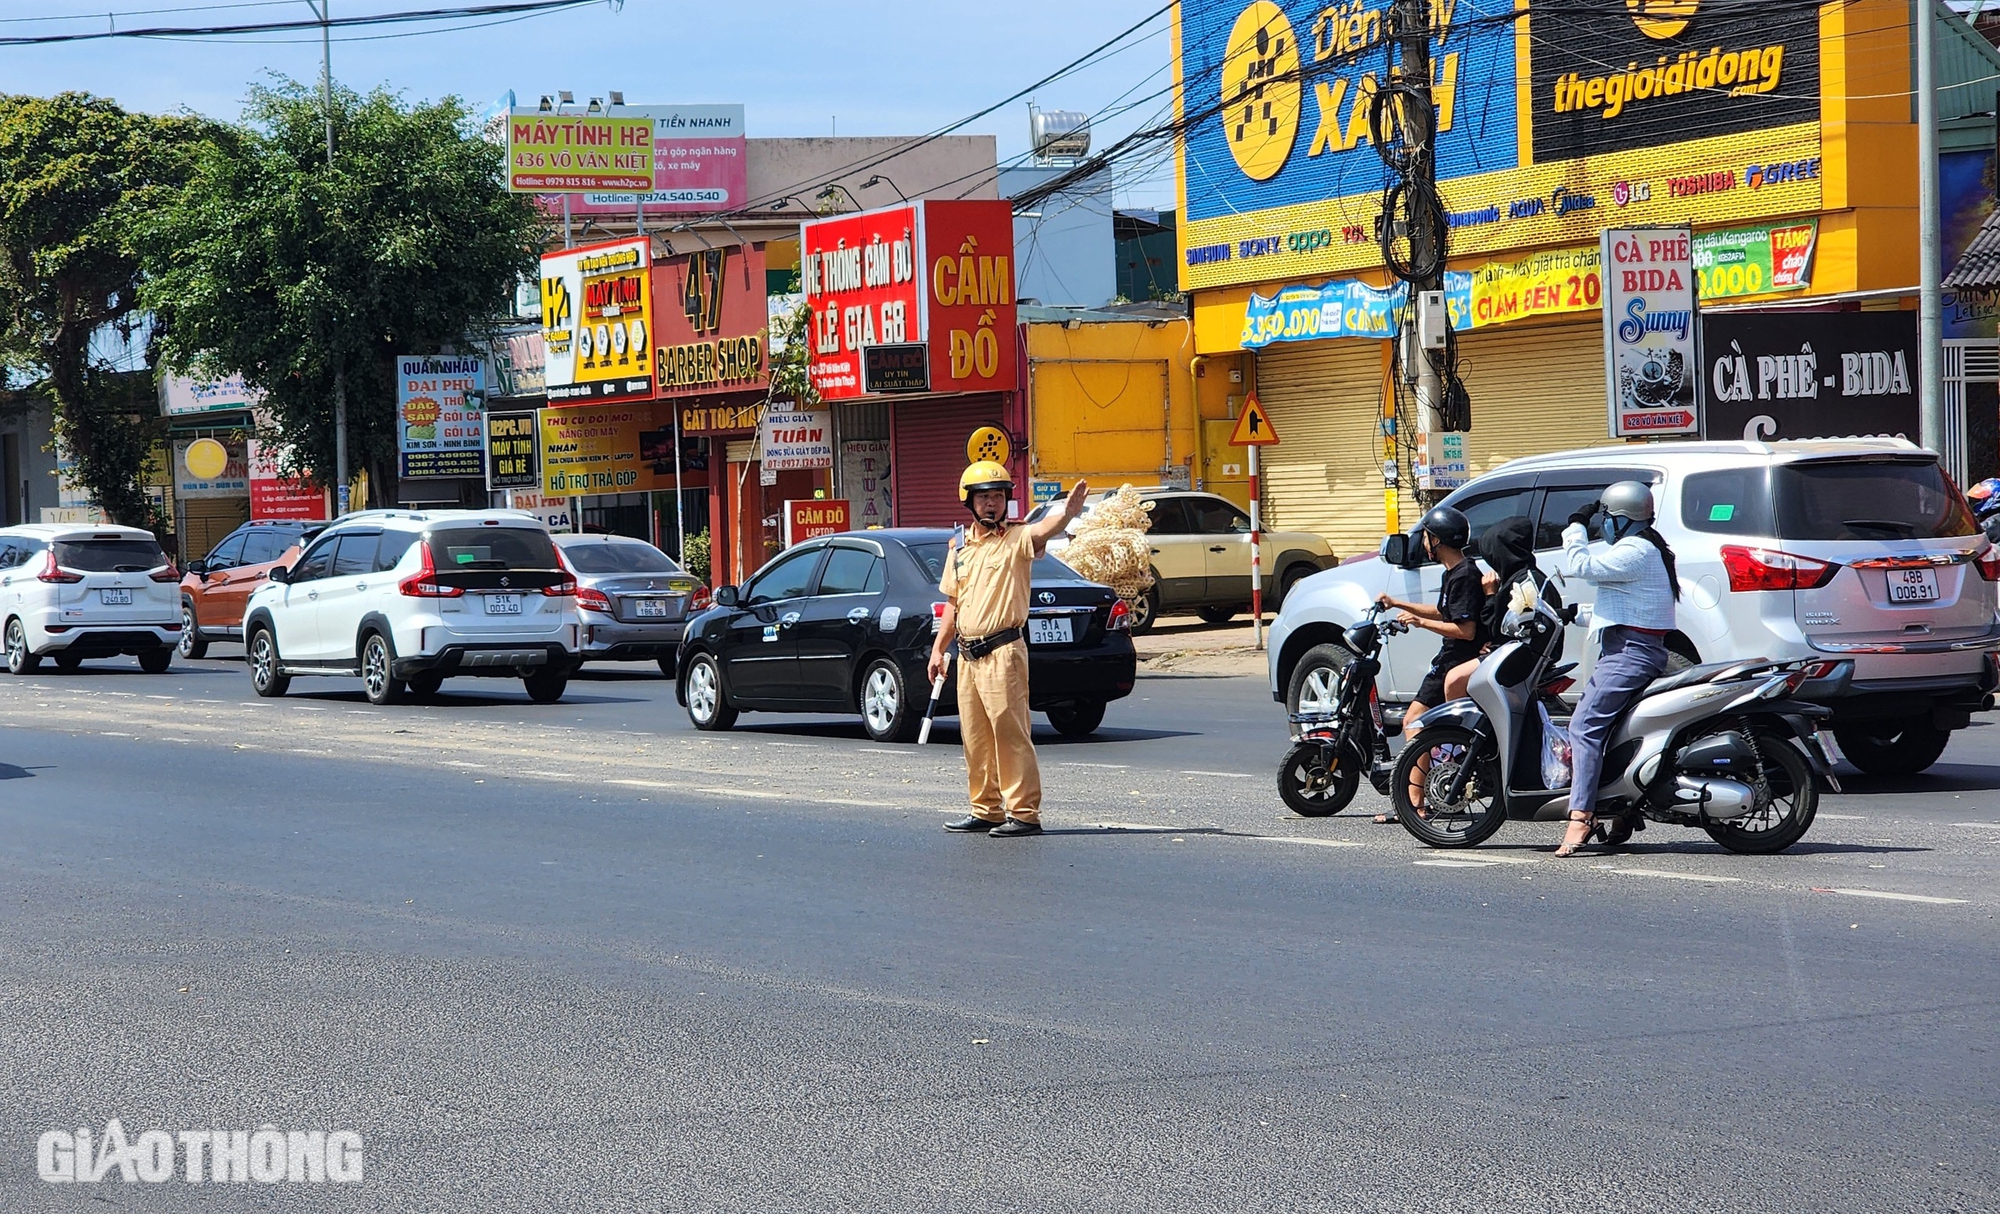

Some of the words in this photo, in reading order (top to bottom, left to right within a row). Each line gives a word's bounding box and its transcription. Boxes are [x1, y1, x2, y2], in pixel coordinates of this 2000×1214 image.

[1554, 45, 1783, 118] thegioididong
[1727, 84, 1758, 98] .com
[660, 113, 686, 128] TIỀN
[689, 117, 731, 127] NHANH
[620, 126, 649, 147] H2
[515, 152, 545, 167] 436
[550, 149, 572, 168] VÕ
[576, 150, 609, 168] VĂN
[614, 151, 648, 172] KIỆT
[670, 147, 687, 157] góp
[689, 146, 712, 157] ngân
[714, 146, 737, 157] hàng
[681, 161, 701, 171] máy
[516, 176, 545, 186] Hotline:
[545, 177, 565, 186] 0979
[566, 178, 580, 187] 815
[582, 178, 596, 187] 816
[1508, 197, 1545, 219] AQUA
[1630, 182, 1651, 202] LG
[1666, 170, 1736, 198] TOSHIBA
[1764, 157, 1821, 184] GREE
[592, 193, 633, 203] Hotline:
[638, 192, 720, 202] 0974.540.540
[1186, 243, 1231, 266] SAMSUNG
[1239, 236, 1281, 258] SONY
[1287, 228, 1331, 253] oppo
[1342, 226, 1368, 243] TCL
[1614, 234, 1643, 263] CÀ
[1649, 232, 1691, 262] PHÊ
[1722, 230, 1768, 247] Kangaroo
[1774, 228, 1811, 252] TẶNG
[823, 236, 862, 292] THỐNG
[864, 232, 890, 287] CẦM
[893, 226, 912, 283] ĐỒ
[1555, 250, 1570, 270] trả
[933, 235, 1010, 307] CẦM
[684, 248, 726, 332] 47
[1622, 269, 1685, 293] BIDA
[1522, 275, 1562, 312] ĐẾN
[815, 300, 839, 353] LÊ
[844, 305, 877, 351] GIA
[880, 300, 907, 343] 68
[1619, 296, 1692, 344] Sunny
[949, 309, 999, 379] ĐỒ
[657, 342, 716, 387] BARBER
[717, 335, 761, 380] SHOP
[1713, 338, 1753, 403] CÀ
[1757, 341, 1819, 400] PHÊ
[1842, 350, 1911, 398] BIDA
[408, 380, 437, 395] ĐẠI
[547, 417, 568, 427] THU
[683, 398, 707, 430] CẮT
[709, 401, 736, 429] TÓC
[1627, 416, 1641, 427] 428
[490, 418, 532, 436] H2PC.VN
[406, 441, 420, 449] KIM
[422, 440, 437, 448] SƠN
[444, 439, 462, 448] NINH
[492, 438, 511, 456] MÁY
[512, 437, 532, 455] TÍNH
[823, 446, 831, 454] DA
[499, 457, 514, 474] GIÁ
[550, 470, 565, 490] HỖ
[568, 473, 590, 491] TRỢ
[592, 467, 613, 488] TRẢ
[616, 468, 637, 486] GÓP
[548, 511, 570, 526] CÁ
[796, 507, 823, 525] CẦM
[826, 506, 844, 524] ĐỒ
[1902, 570, 1923, 584] 48B
[495, 595, 511, 604] 51K
[1896, 585, 1934, 600] 008.91
[490, 604, 518, 613] 003.40
[1040, 619, 1060, 631] 81A
[1034, 630, 1069, 643] 319.21
